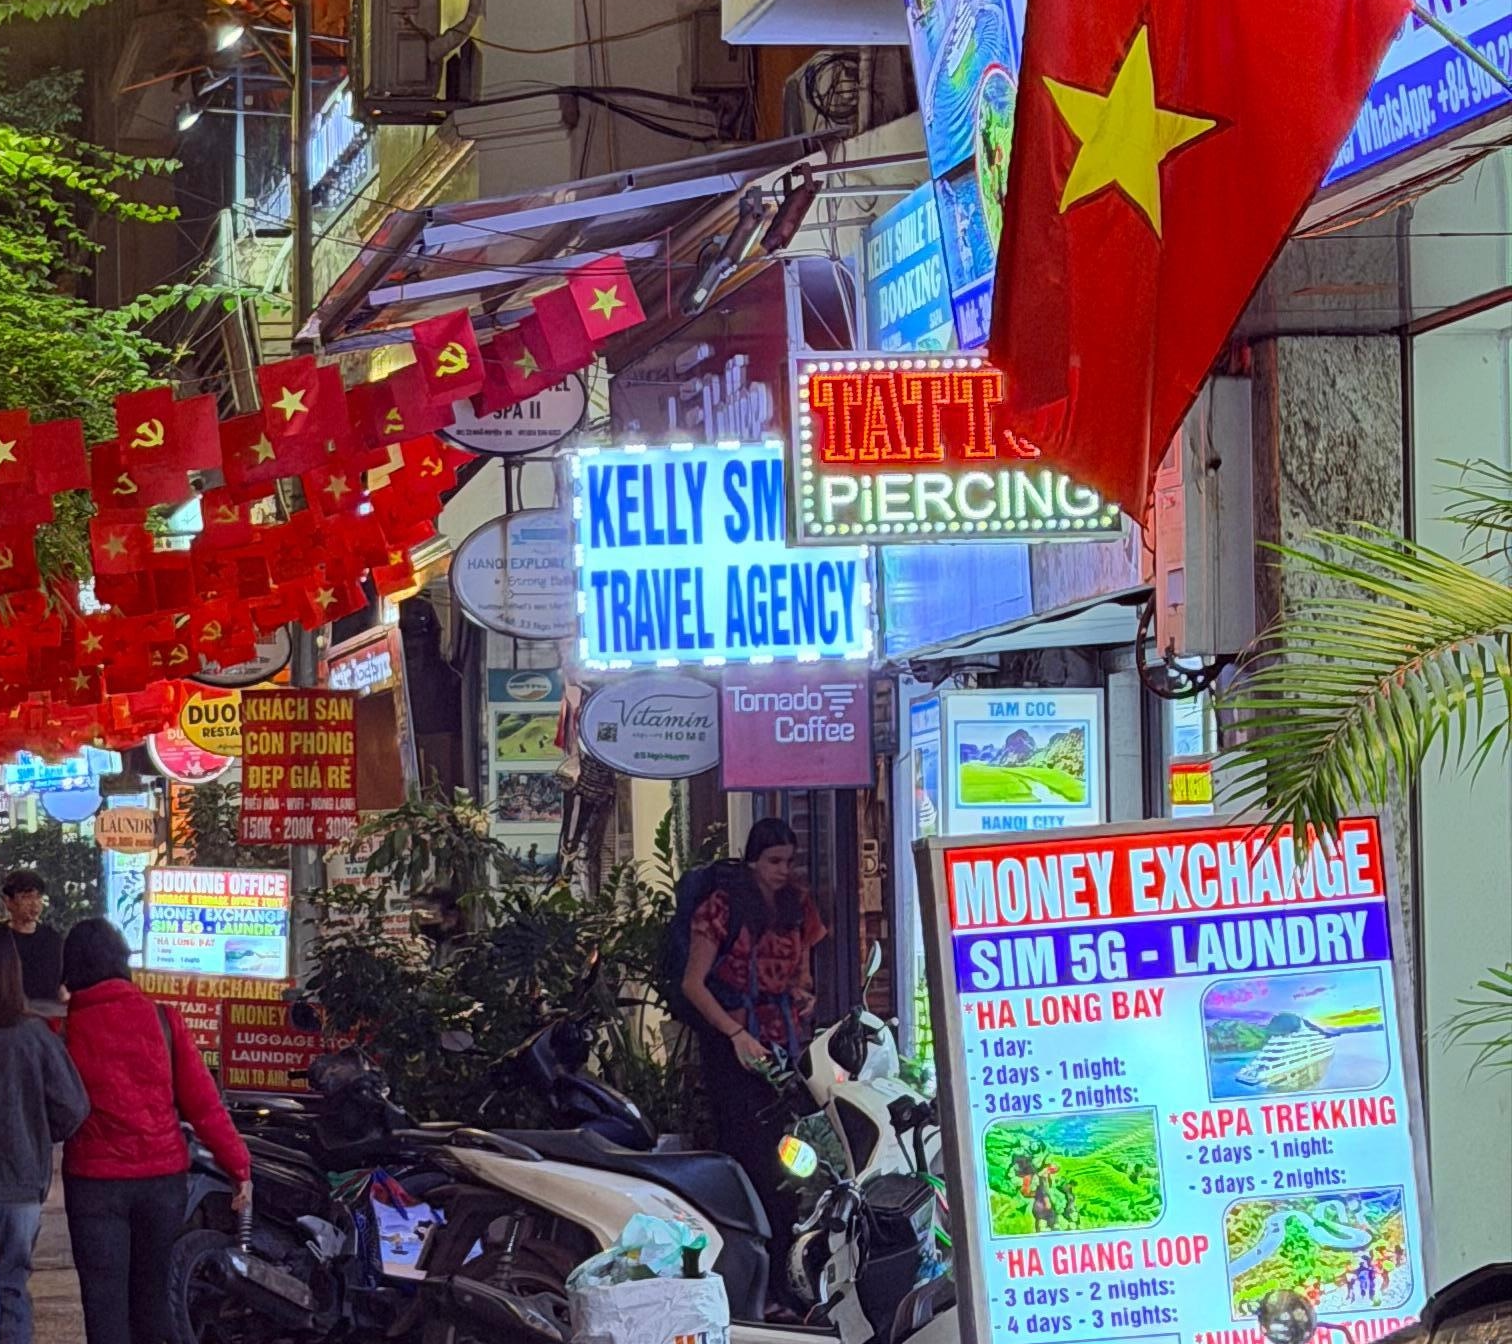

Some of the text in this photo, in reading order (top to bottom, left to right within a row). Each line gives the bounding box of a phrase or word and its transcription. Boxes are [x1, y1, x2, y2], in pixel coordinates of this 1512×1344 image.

[879, 254, 941, 330] BOOKING
[588, 461, 707, 548] KELLY
[591, 560, 856, 653] TRAVEL AGENCY
[246, 693, 354, 725] KHÁCH SẠN
[610, 694, 713, 728] Vitamin
[727, 685, 822, 712] Tornado
[989, 701, 1056, 716] TAM COC
[290, 726, 354, 755] PHÒNG
[775, 716, 854, 743] Coffee
[248, 765, 284, 793] ĐẸP
[290, 760, 322, 788] GIÁ
[101, 819, 159, 834] LAUNDRY
[243, 816, 272, 840] 150K
[283, 816, 314, 840] 200K
[982, 815, 1065, 831] HANOI CITY
[151, 870, 287, 896] BOOKING OFFICE
[952, 830, 1374, 927] MONEY EXCHANGE
[151, 906, 285, 923] MONEY EXCHANGE
[151, 921, 178, 933] SIM
[216, 921, 282, 935] LAUNDRY
[970, 910, 1368, 990] SIM 5G LAUNDRY
[231, 1004, 287, 1025] MONEY
[1025, 993, 1102, 1027] LONG
[1112, 987, 1165, 1020] BAY
[236, 1033, 314, 1048] LUGGAGE
[231, 1050, 304, 1065] LAUNDRY
[229, 1069, 265, 1085] TAXI TO
[1260, 1095, 1397, 1134] TREKKING
[1052, 1240, 1134, 1275] GIANG
[1142, 1235, 1209, 1268] LOOP
[1004, 1278, 1176, 1307] 3 days 2 nights:
[1007, 1305, 1178, 1334] 4 days 3 nights:
